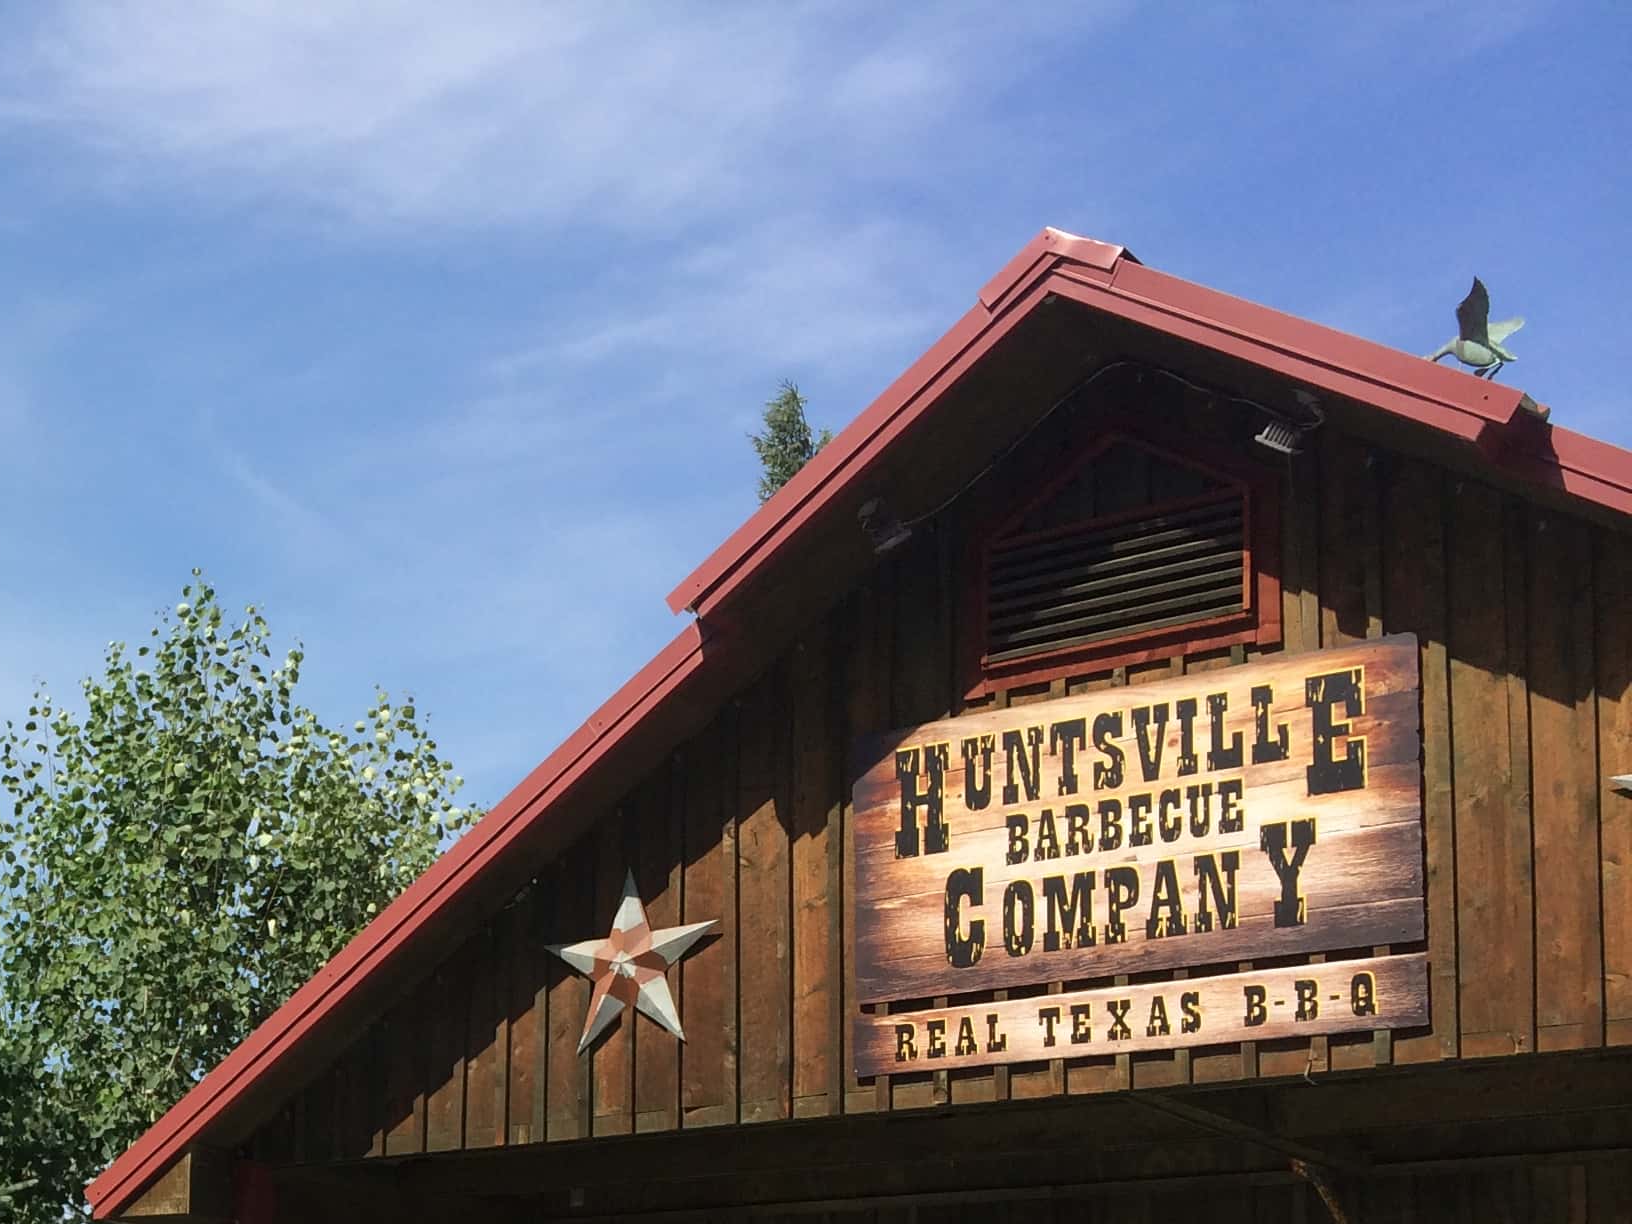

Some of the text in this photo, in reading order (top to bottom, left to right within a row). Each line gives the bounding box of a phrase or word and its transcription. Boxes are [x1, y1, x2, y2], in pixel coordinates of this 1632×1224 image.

[894, 665, 1366, 859] HUNTSVILLE
[1005, 779, 1244, 865] BARBECUE
[944, 819, 1317, 968] COMPANY
[894, 973, 1378, 1062] REAL TEXAS B-B-Q
